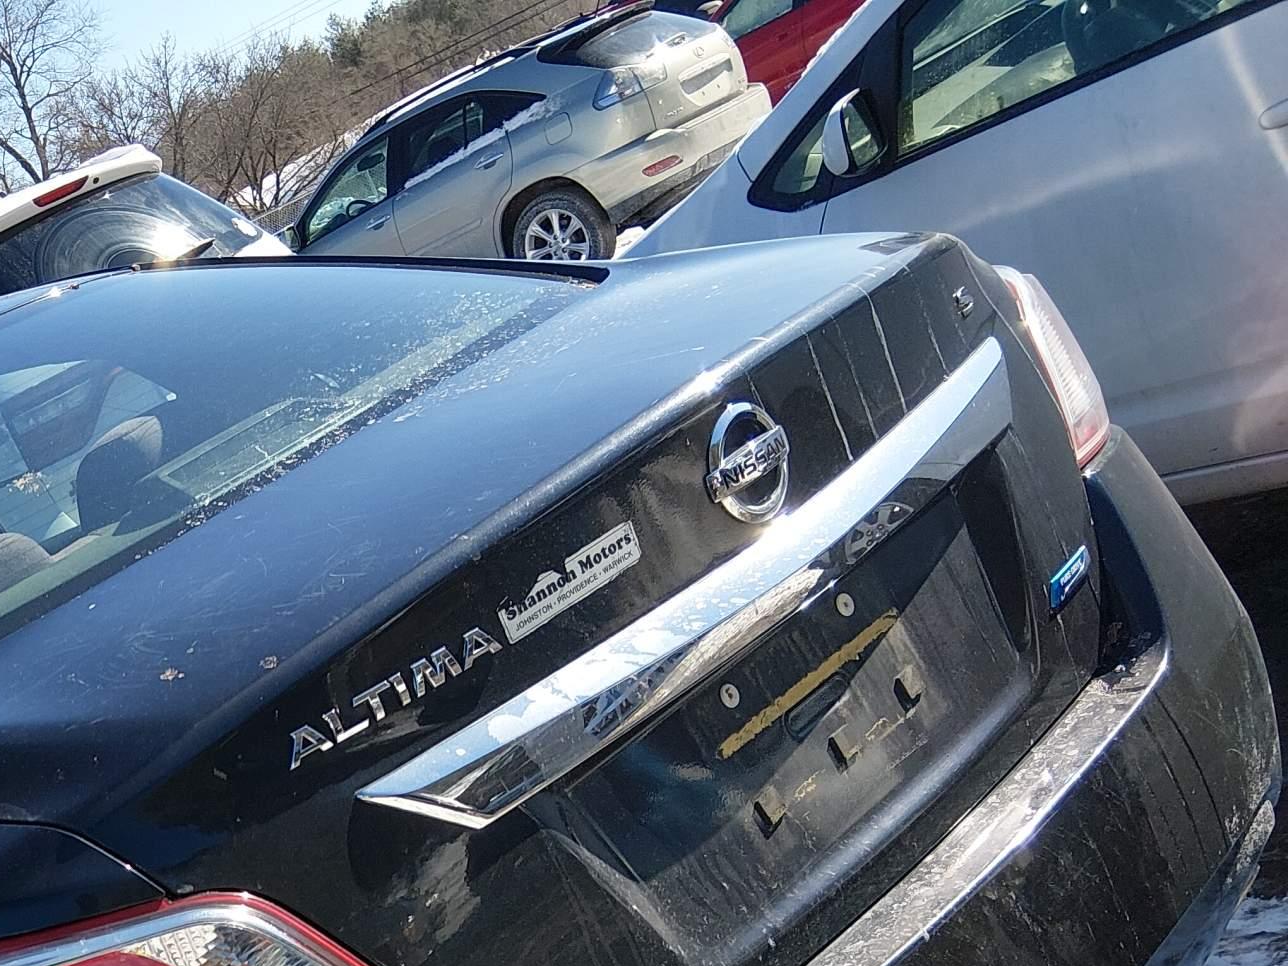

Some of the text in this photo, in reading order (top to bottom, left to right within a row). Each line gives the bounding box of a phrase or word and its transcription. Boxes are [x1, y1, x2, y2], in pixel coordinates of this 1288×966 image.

[719, 434, 787, 489] NISSAN
[577, 533, 632, 575] Motors
[514, 549, 633, 632] JOHNSTON PROVIDENCE WARWICK
[289, 626, 504, 771] ALTIMA
